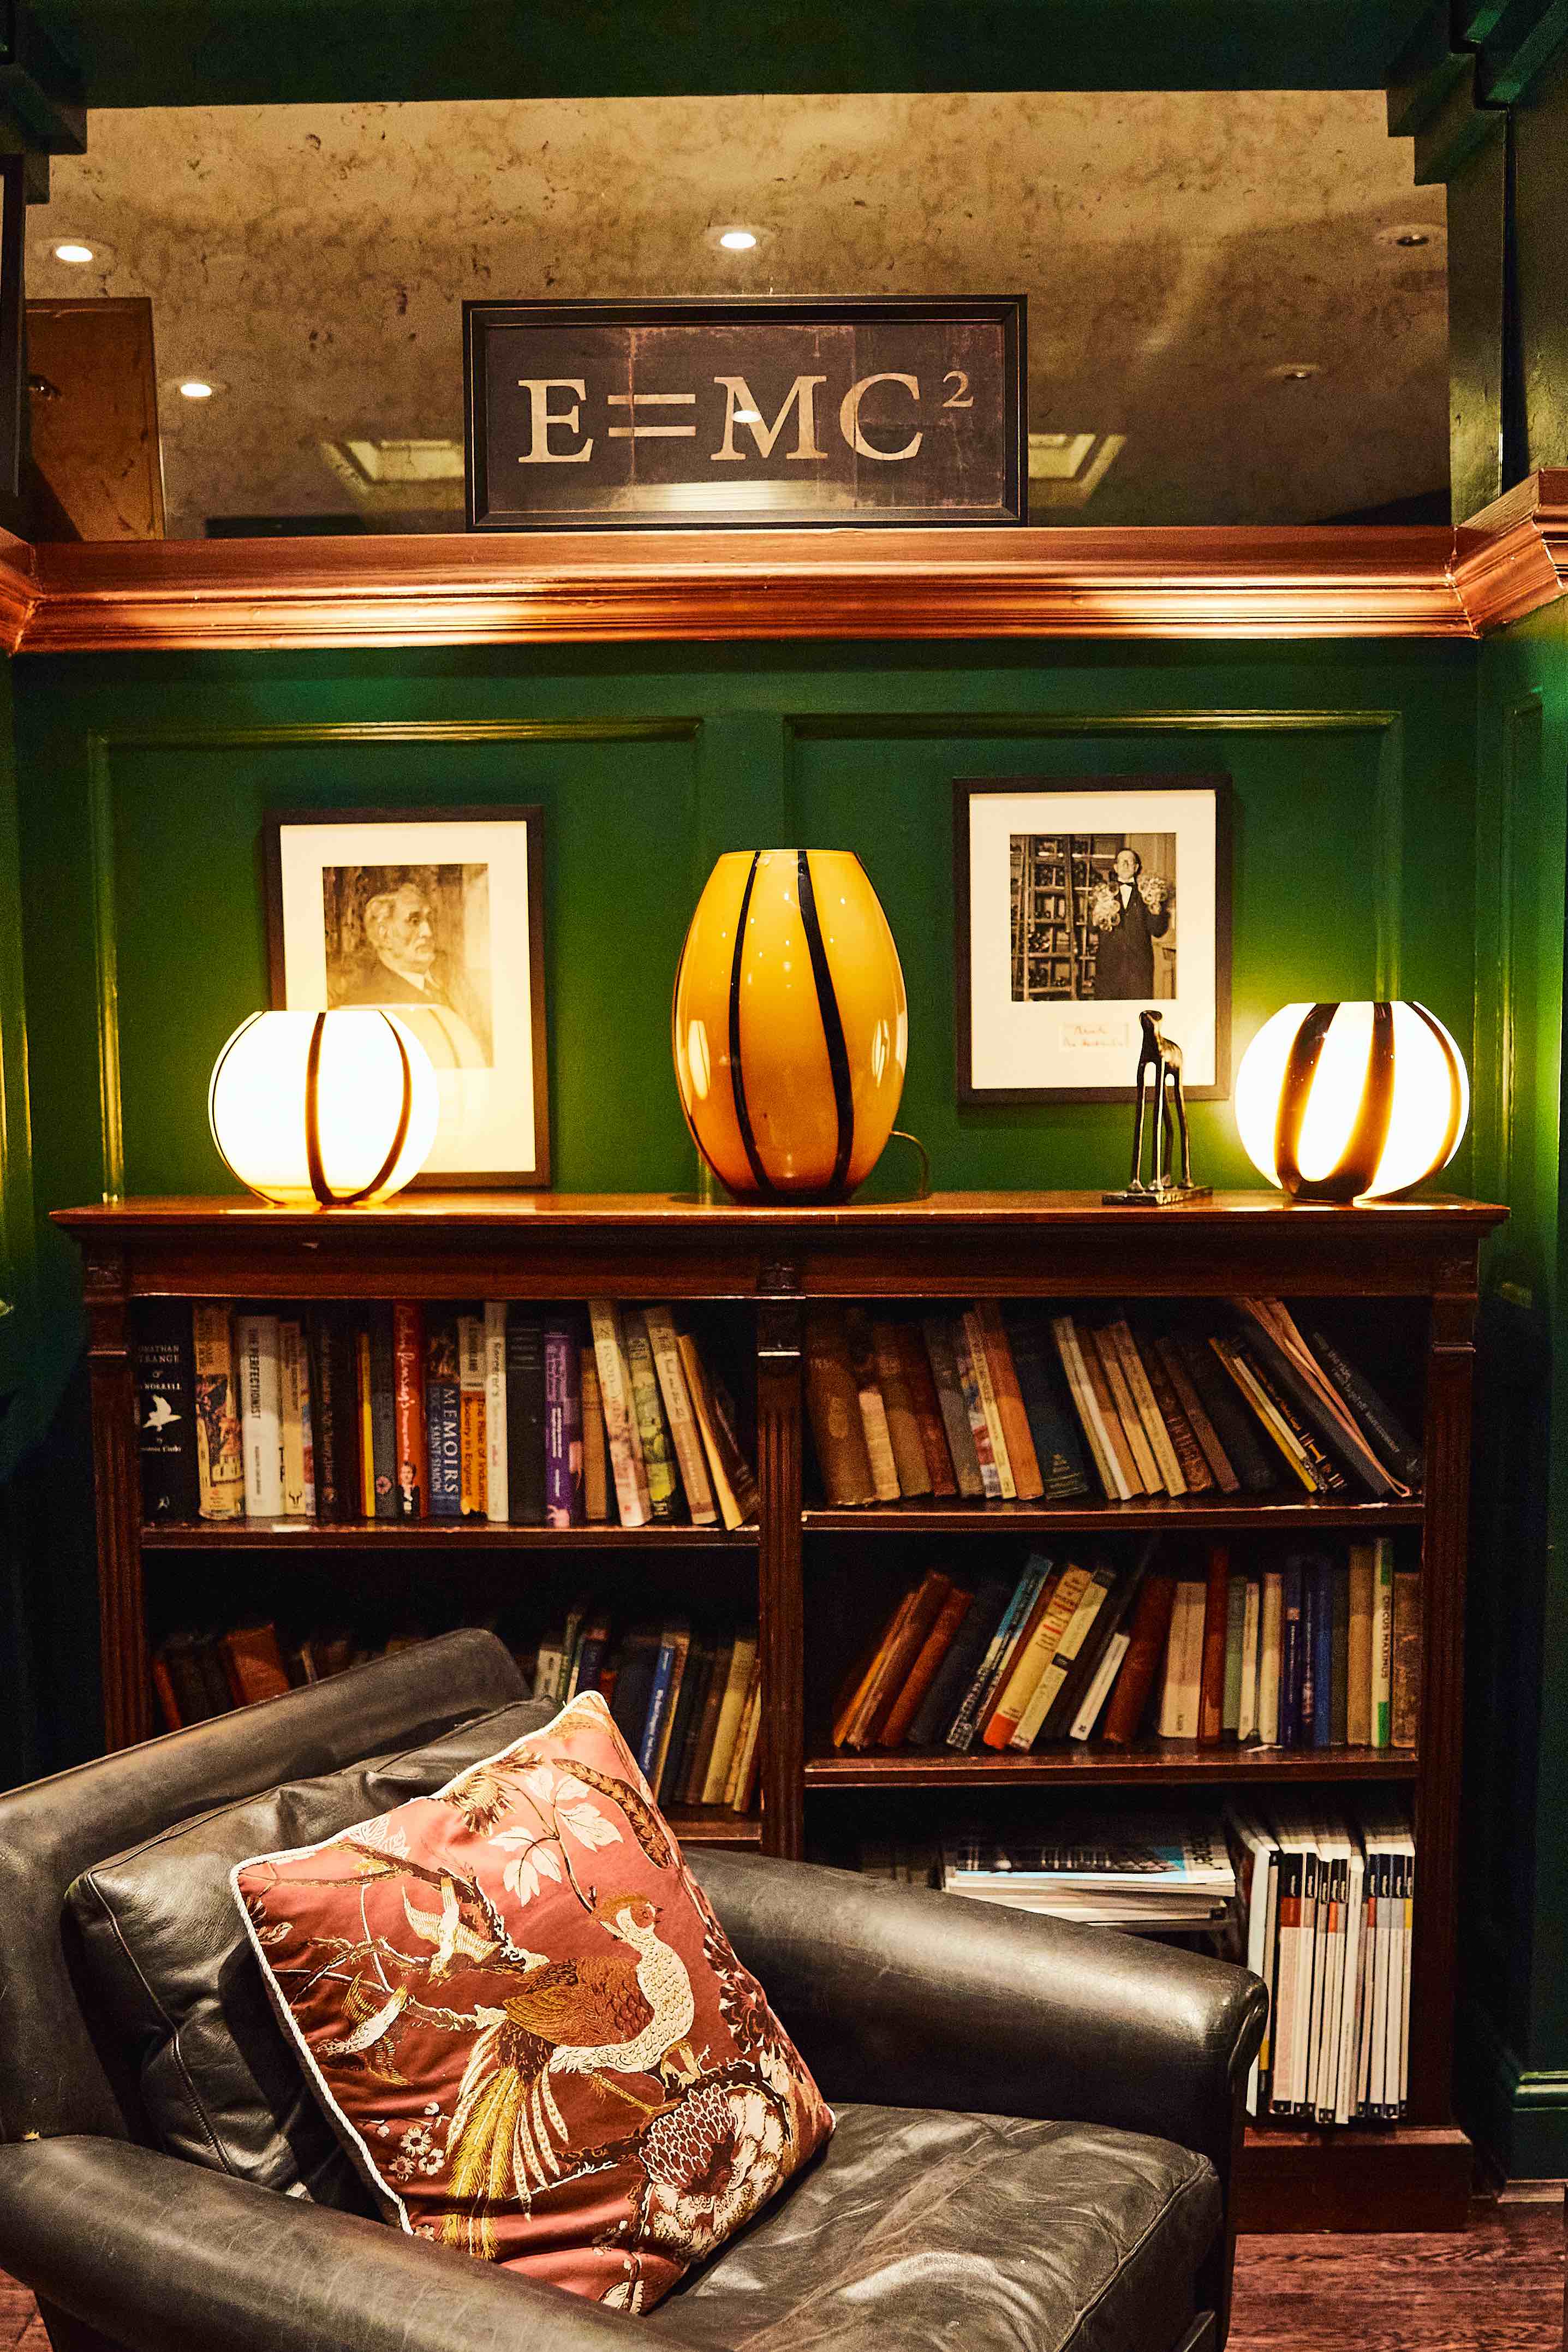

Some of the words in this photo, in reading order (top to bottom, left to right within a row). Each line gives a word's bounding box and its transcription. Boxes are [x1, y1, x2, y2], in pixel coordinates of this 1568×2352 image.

[249, 1348, 261, 1419] PERFECTIONIST
[463, 1397, 473, 1436] Society
[476, 1397, 485, 1416] The
[443, 1388, 458, 1493] MEMOIRS
[476, 1420, 485, 1444] Rise
[476, 1448, 486, 1459] of
[463, 1453, 473, 1496] England
[1381, 1633, 1390, 1679] MAXIMUS
